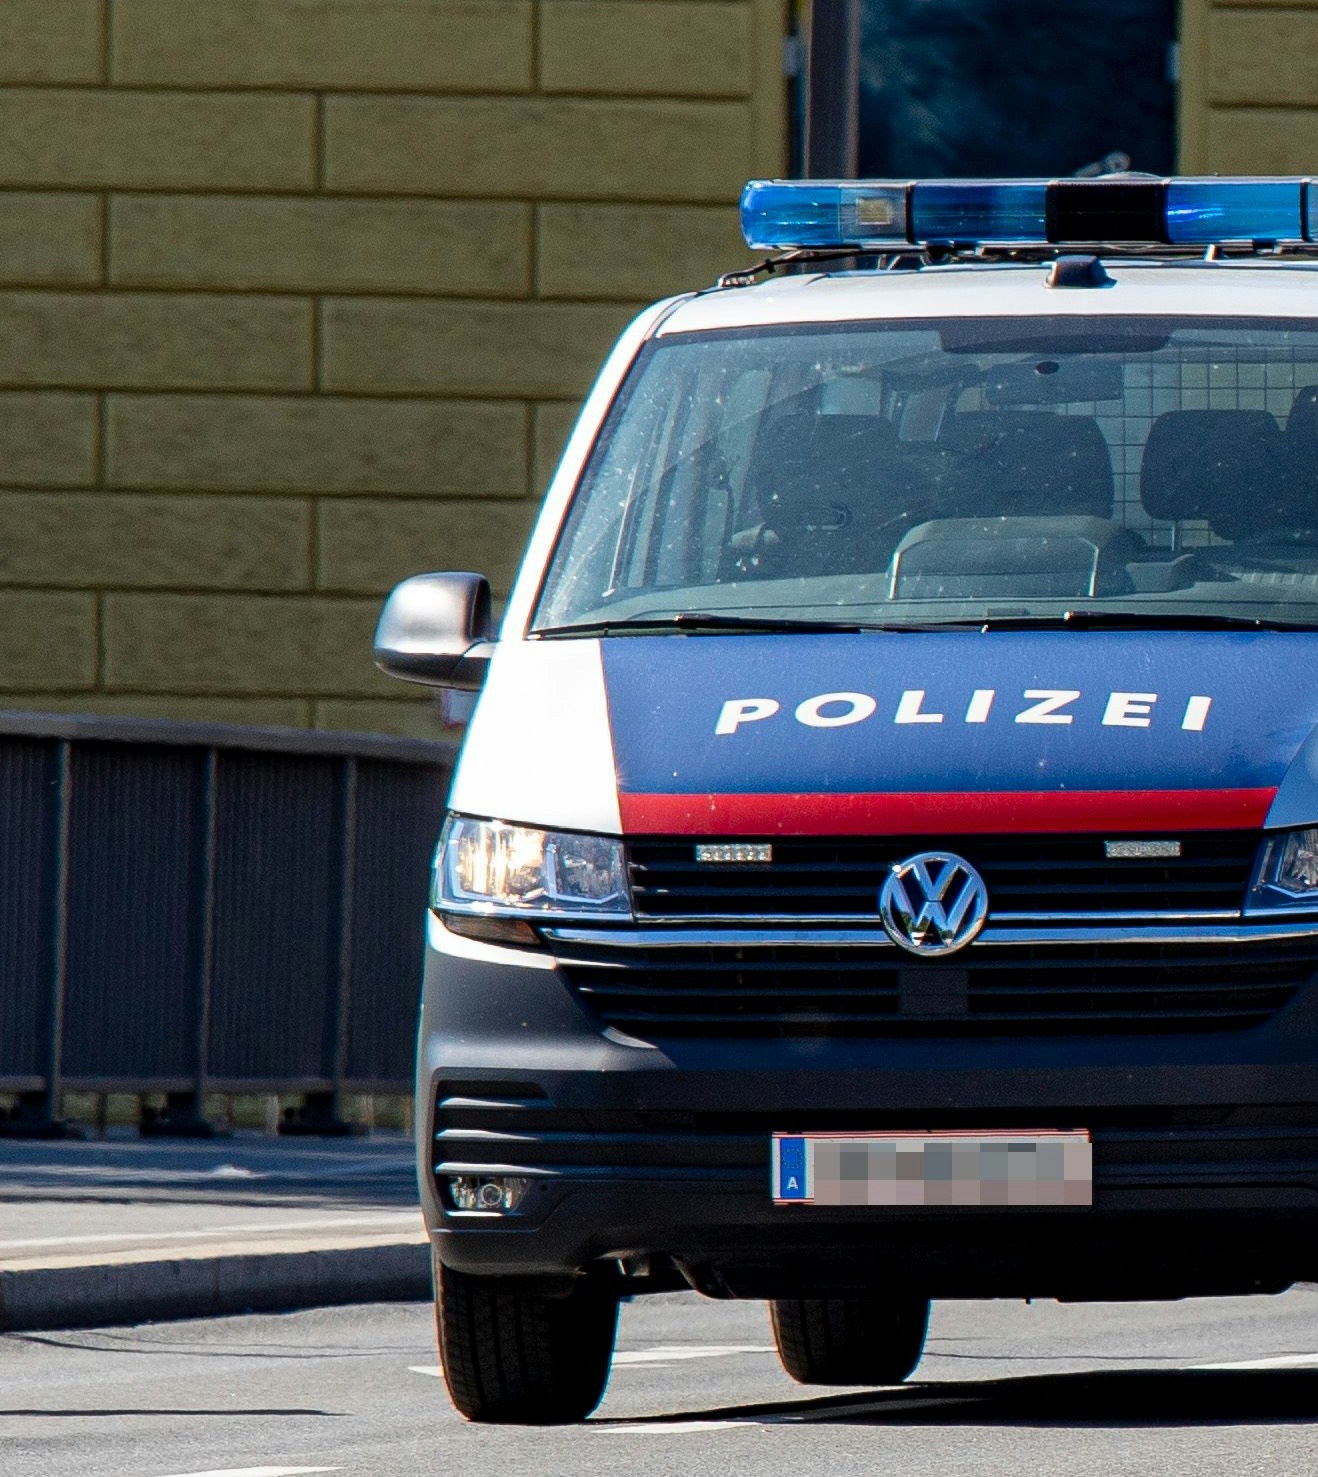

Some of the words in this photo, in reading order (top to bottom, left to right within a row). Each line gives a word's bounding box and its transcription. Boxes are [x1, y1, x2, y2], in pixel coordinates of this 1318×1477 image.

[714, 688, 1212, 736] POLIZEI
[882, 853, 986, 955] VW
[786, 1176, 799, 1190] A
